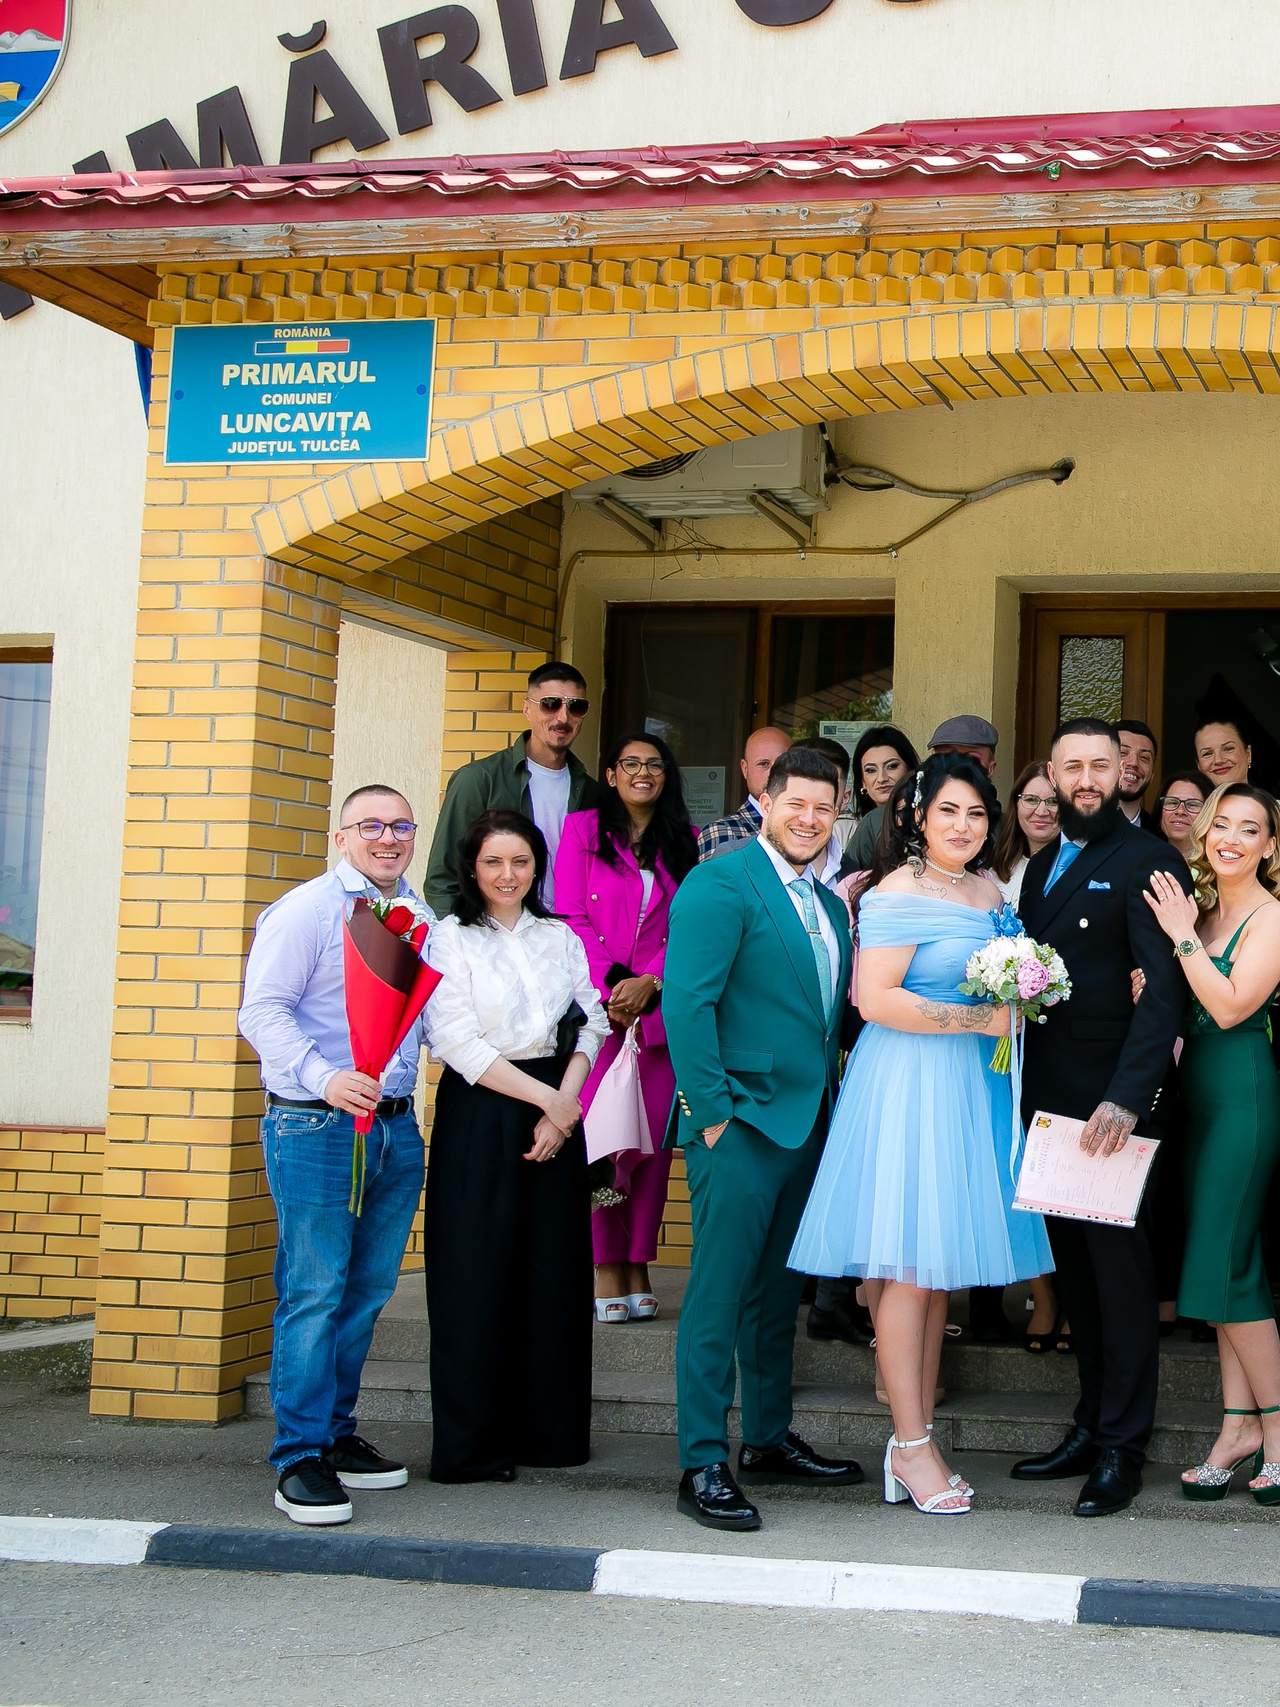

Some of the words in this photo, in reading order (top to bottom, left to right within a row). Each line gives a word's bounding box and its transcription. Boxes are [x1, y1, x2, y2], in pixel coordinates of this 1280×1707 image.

[273, 326, 331, 338] ROMÂNIA
[222, 360, 376, 386] PRIMARUL
[261, 392, 332, 406] COMUNEI
[220, 411, 372, 438] LUNCAVIȚA
[227, 440, 297, 456] JUDEȚUL
[301, 439, 361, 453] TULCEA
